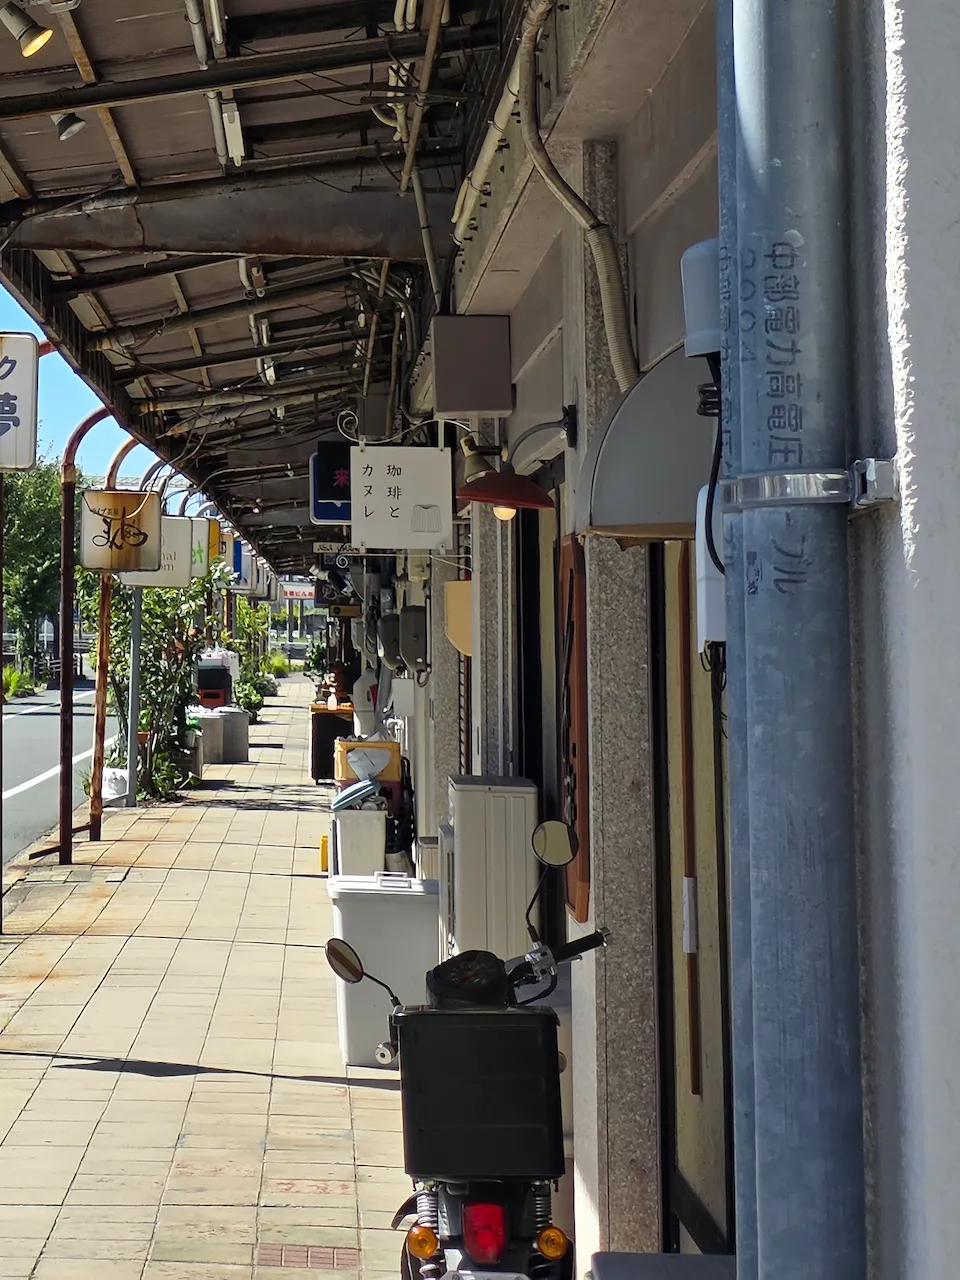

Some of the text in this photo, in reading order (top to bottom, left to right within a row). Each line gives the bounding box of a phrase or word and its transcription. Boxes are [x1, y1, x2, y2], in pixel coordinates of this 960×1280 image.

[362, 464, 374, 518] カヌレ
[386, 464, 402, 518] 珈琲と
